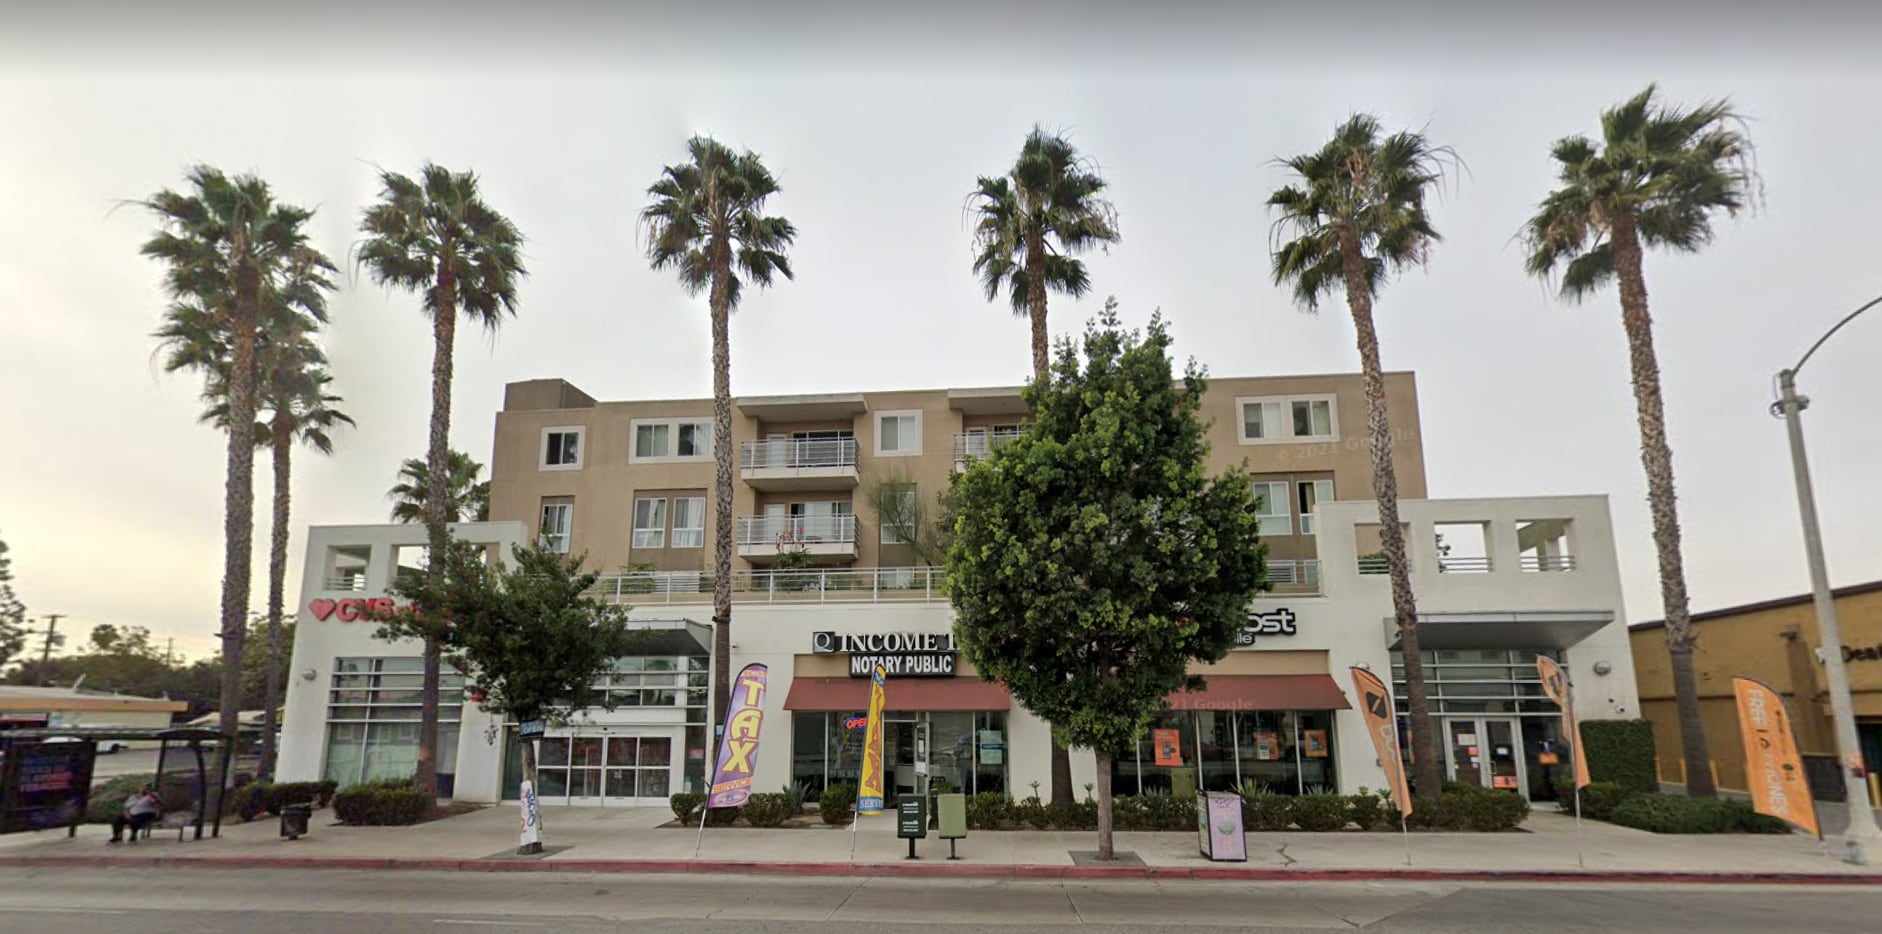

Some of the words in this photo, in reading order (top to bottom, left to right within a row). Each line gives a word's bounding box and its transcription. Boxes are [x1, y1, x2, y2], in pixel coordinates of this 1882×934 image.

[335, 598, 394, 622] CVS
[1244, 610, 1295, 632] ost
[814, 632, 834, 652] Q
[839, 631, 938, 652] INCOME
[851, 656, 903, 673] NOTARY
[905, 655, 953, 673] PUBLIC
[720, 679, 766, 775] TAX
